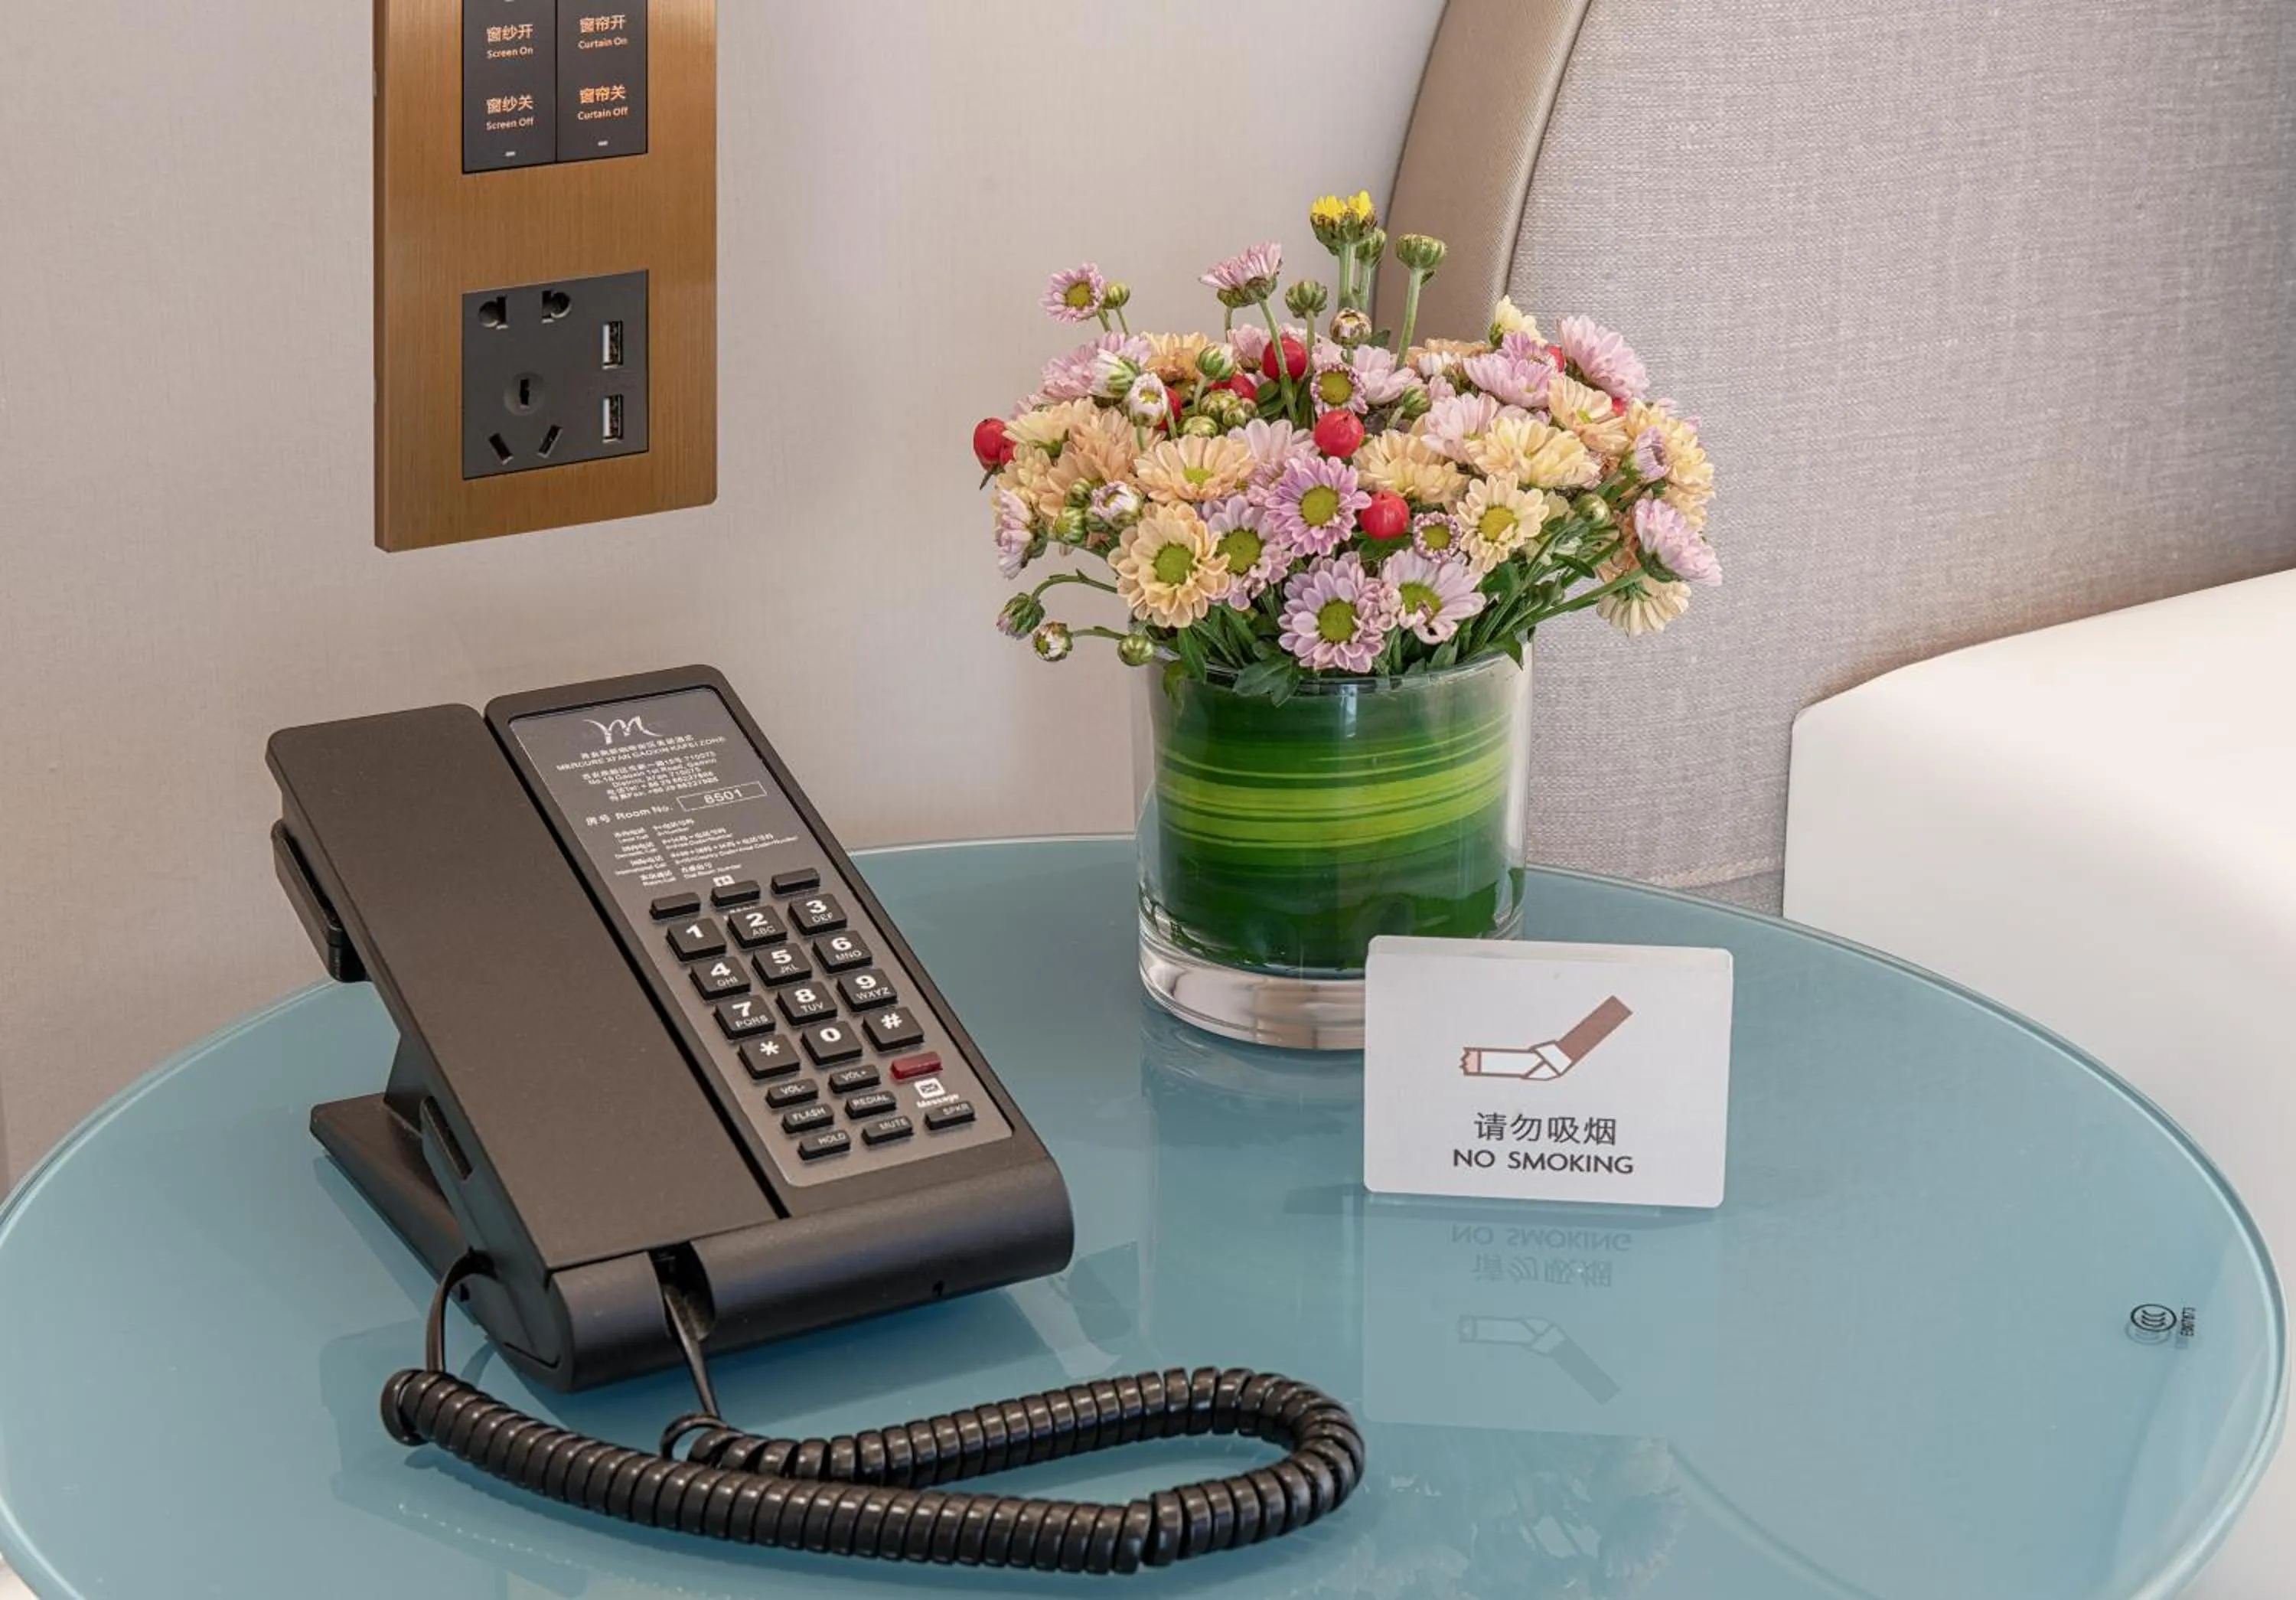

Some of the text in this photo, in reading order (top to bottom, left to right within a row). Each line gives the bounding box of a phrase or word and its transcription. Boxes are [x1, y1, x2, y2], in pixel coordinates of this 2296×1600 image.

[579, 15, 626, 33] 窗帘开
[486, 24, 533, 43] 窗纱开
[578, 37, 628, 50] Curtain On
[486, 46, 533, 59] Screen On
[579, 84, 626, 103] 窗帘关
[486, 95, 533, 114] 窗纱关
[577, 106, 628, 120] Curtain Off
[486, 117, 534, 131] Screen Off
[704, 788, 743, 804] 8501
[615, 808, 651, 821] Room
[805, 900, 827, 914] 3
[745, 913, 768, 927] 2
[811, 913, 833, 923] DEF
[686, 924, 705, 939] 1
[831, 936, 852, 951] 6
[771, 949, 792, 965] 5
[835, 949, 863, 961] MNO
[710, 962, 731, 977] 4
[780, 964, 800, 975] JKL
[716, 975, 739, 988] GHI
[855, 975, 876, 989] 9
[794, 988, 817, 1003] 8
[856, 986, 892, 1001] WXYZ
[732, 1001, 752, 1017] 7
[800, 1001, 824, 1014] TUV
[735, 1014, 768, 1029] PQRS
[881, 1012, 902, 1030] #
[820, 1027, 841, 1043] 0
[852, 1094, 890, 1107] REDIAL
[916, 1093, 960, 1109] Message
[792, 1106, 827, 1121] FLASH
[942, 1102, 970, 1115] SPKR
[878, 1118, 908, 1131] MUTE
[1473, 1111, 1617, 1147] 请勿吸烟
[818, 1132, 846, 1145] HOLD
[1453, 1148, 1634, 1174] NO SMOKING
